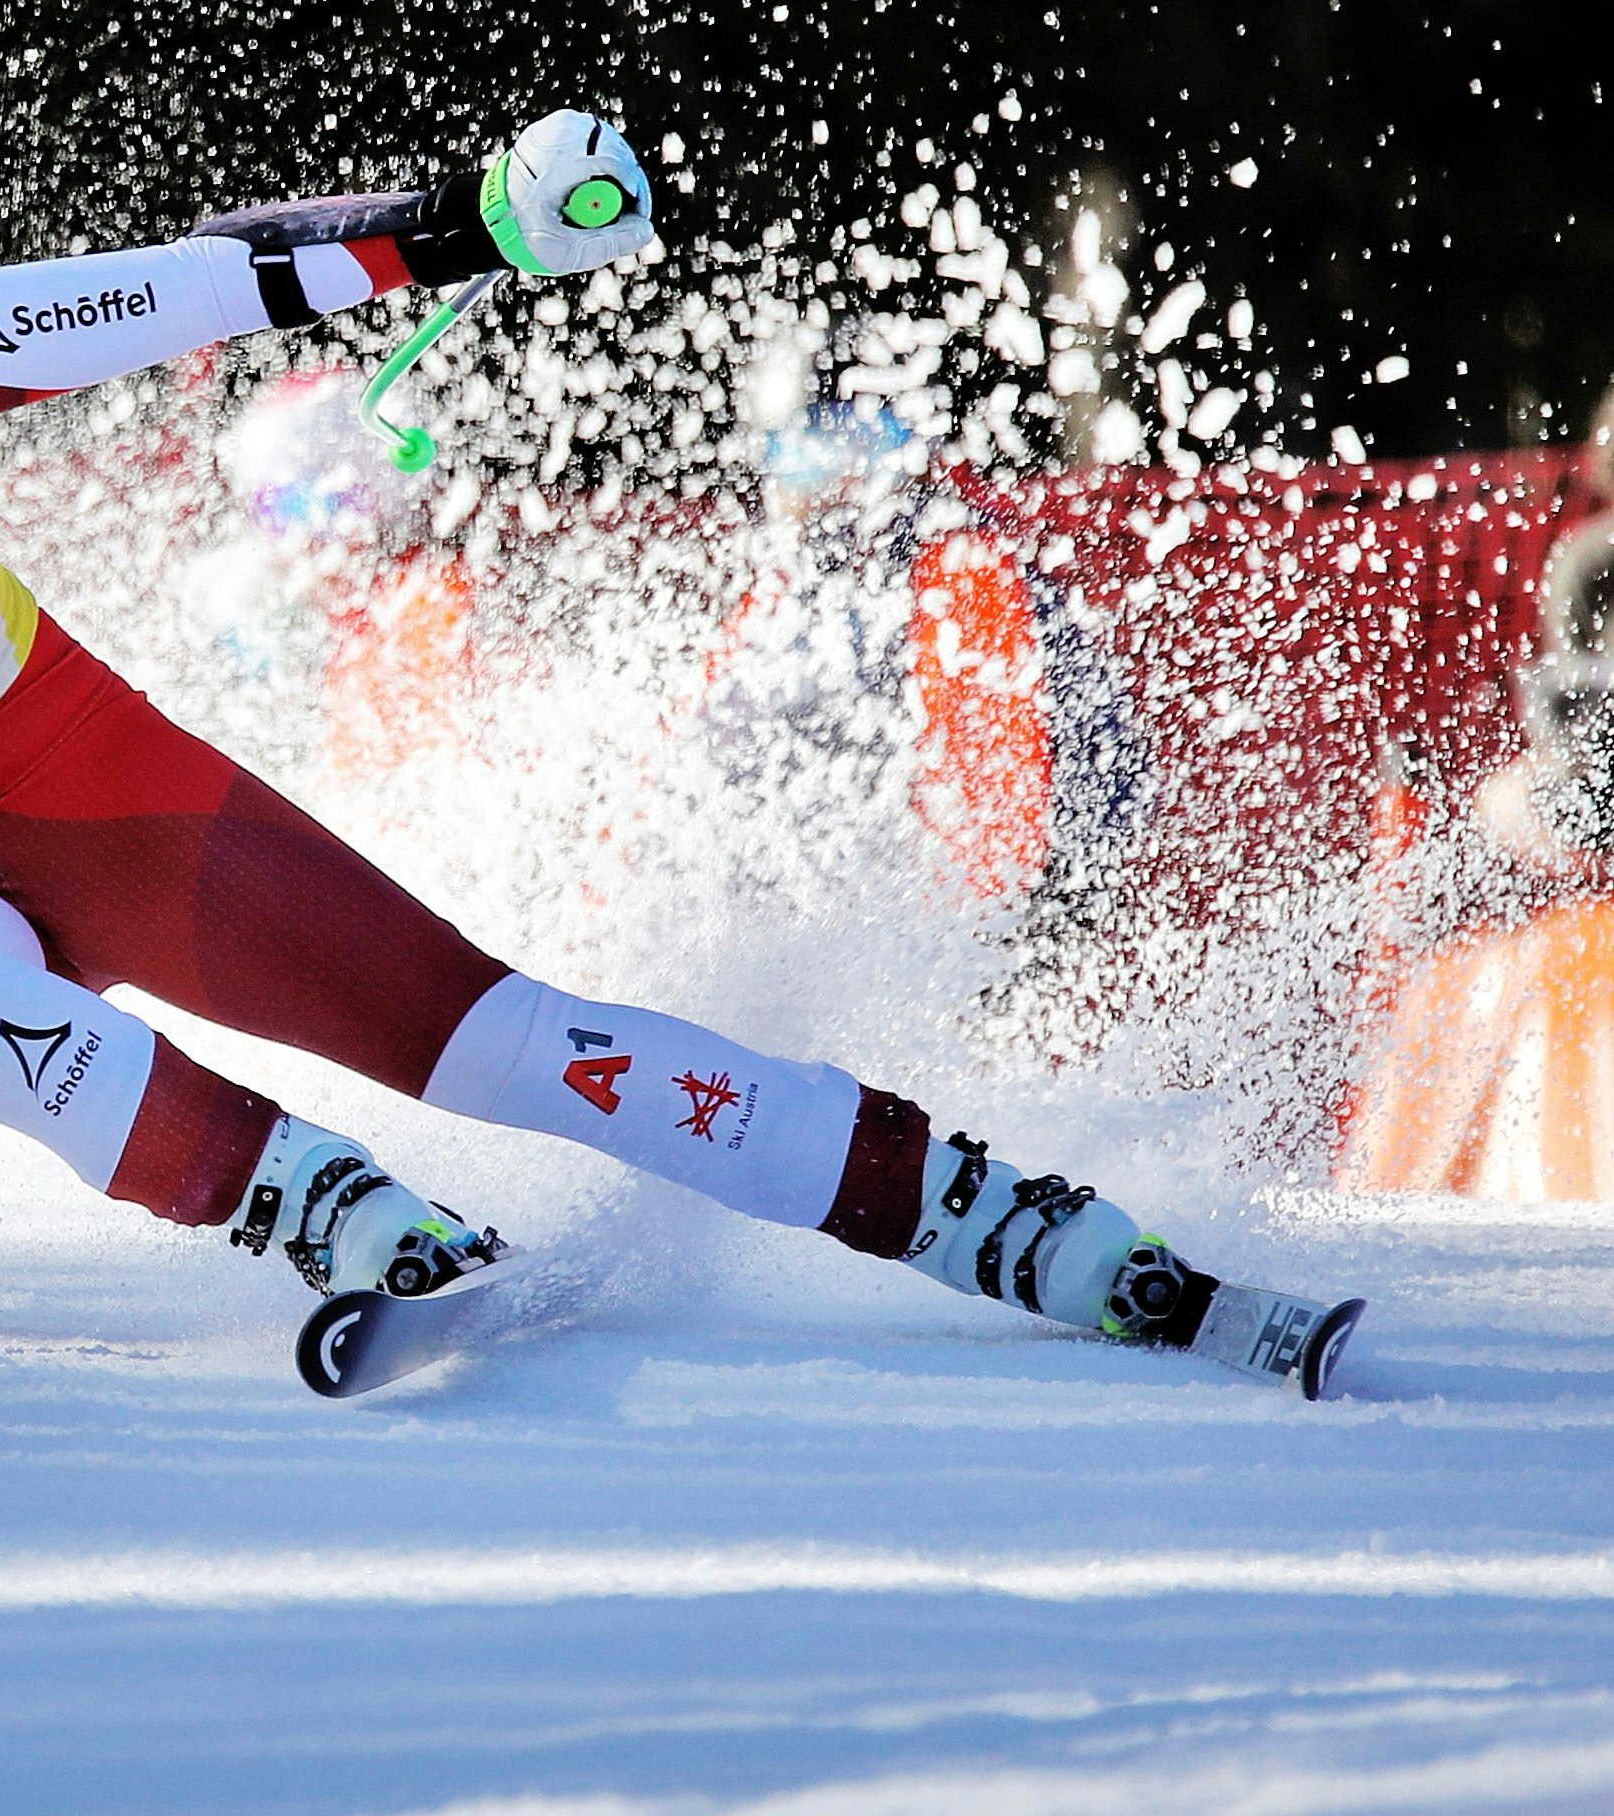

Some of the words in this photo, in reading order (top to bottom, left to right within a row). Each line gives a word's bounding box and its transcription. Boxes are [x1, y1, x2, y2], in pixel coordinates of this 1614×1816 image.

[12, 281, 157, 336] Schöffel
[44, 1030, 102, 1117] Schöffel
[562, 1027, 633, 1116] A1
[728, 1129, 747, 1151] Ski
[738, 1083, 759, 1128] Austria
